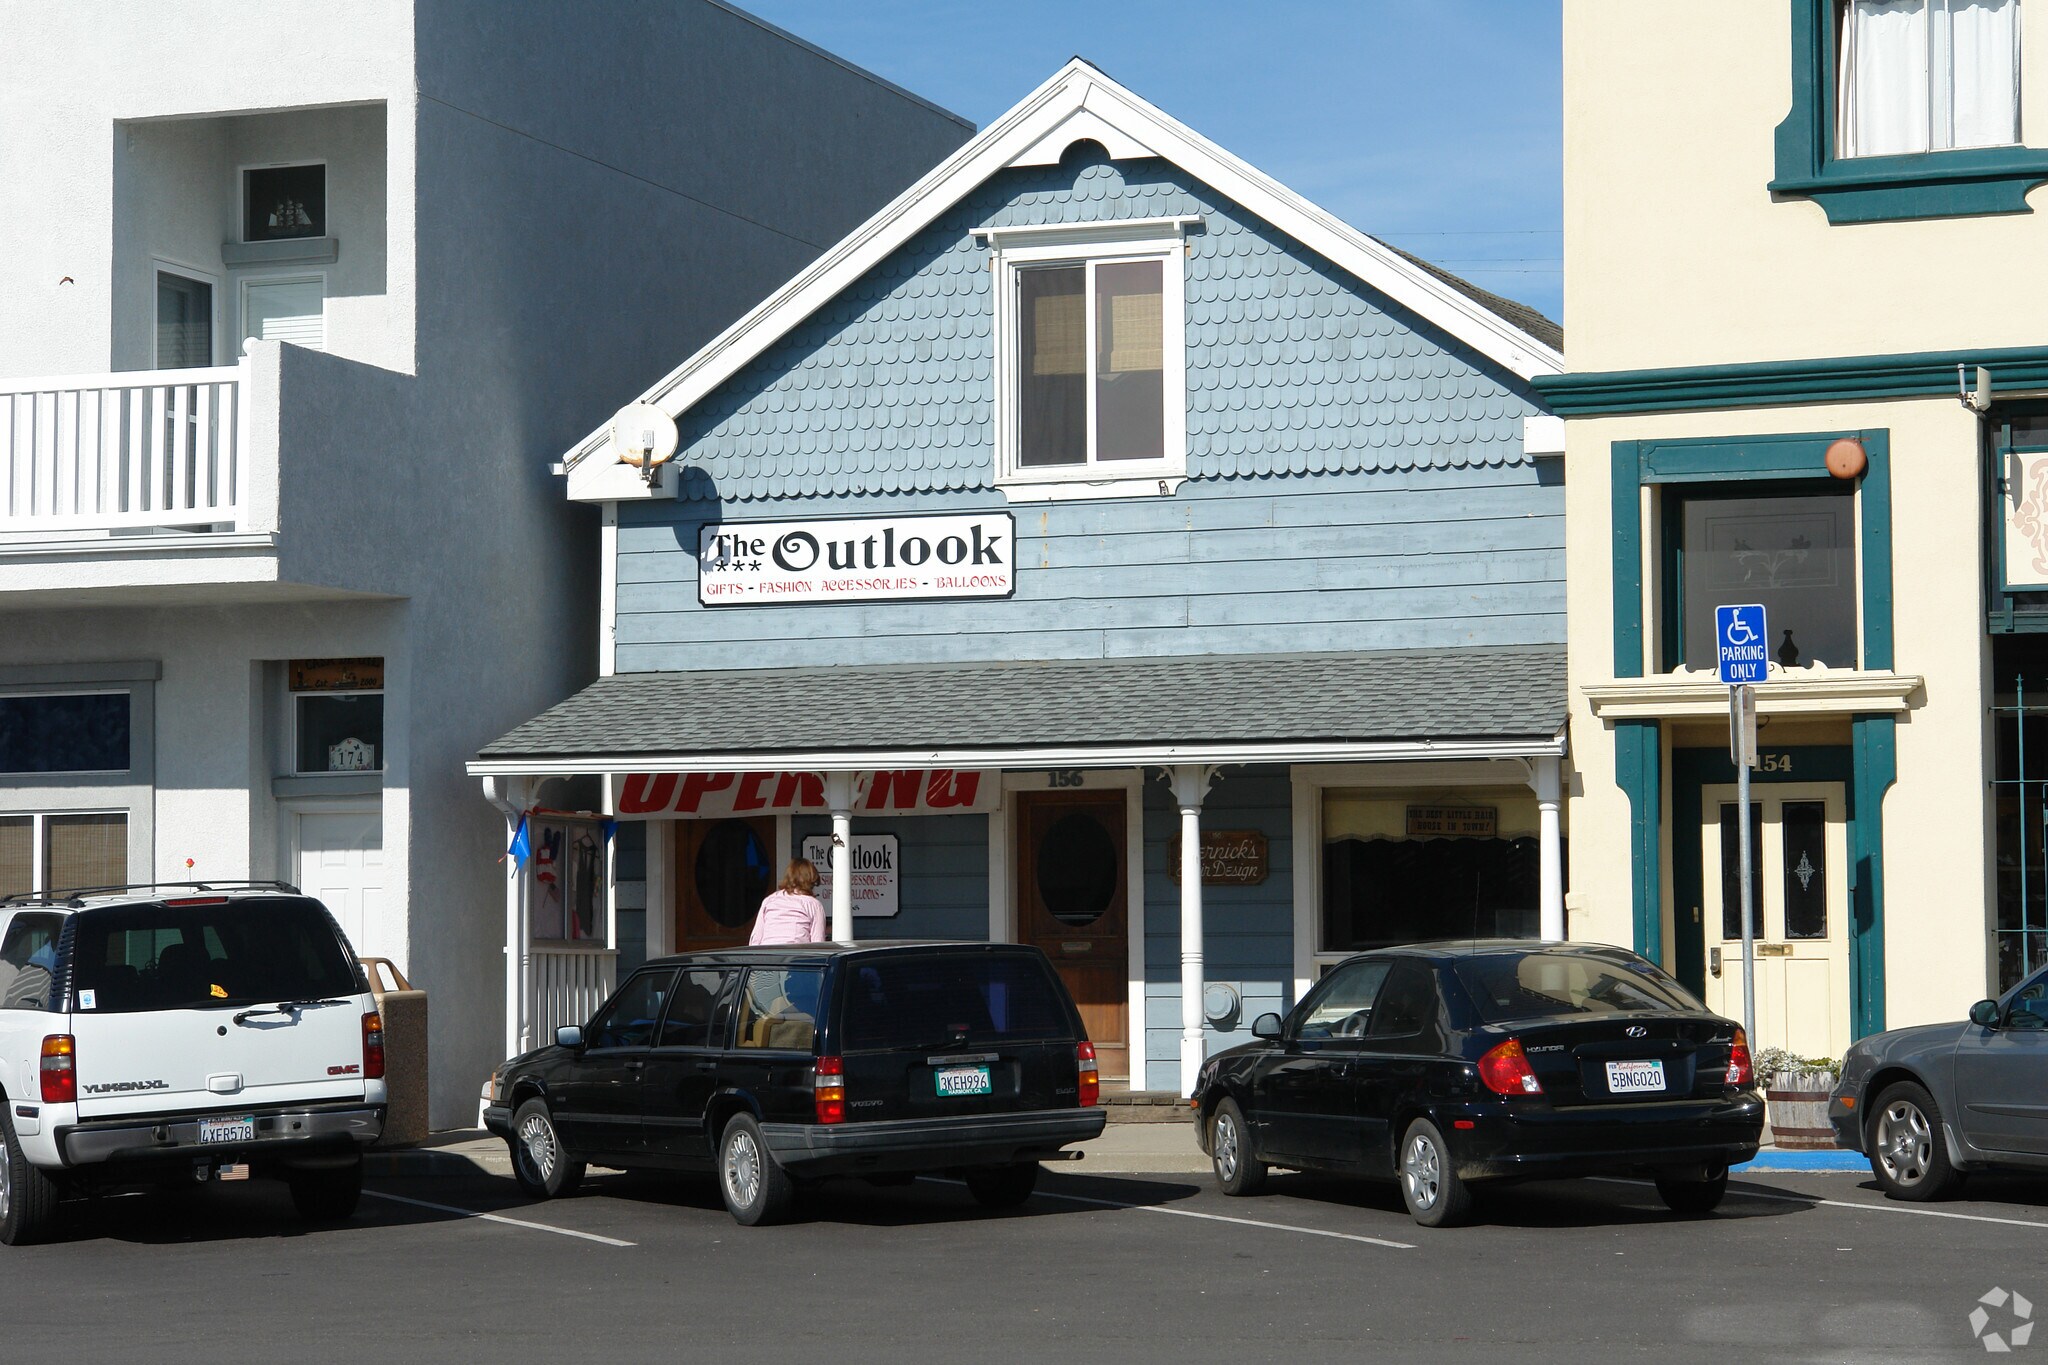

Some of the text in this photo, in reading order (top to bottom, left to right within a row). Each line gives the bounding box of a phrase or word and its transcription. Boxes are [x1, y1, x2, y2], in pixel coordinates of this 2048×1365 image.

[710, 524, 1003, 572] The Outlook
[707, 582, 744, 595] GIFTS
[759, 581, 812, 594] FASHION
[821, 577, 918, 592] ACCESSORIES
[934, 575, 1007, 589] BALLOONS
[1721, 645, 1764, 661] PARKING
[1730, 663, 1757, 679] ONLY
[339, 751, 363, 765] 174
[1752, 753, 1792, 772] 154
[1048, 770, 1084, 787] 156
[618, 768, 981, 813] OPENNG
[809, 844, 892, 870] The Otlook
[1180, 840, 1259, 859] ernick's
[1213, 860, 1257, 880] Design
[851, 874, 887, 886] ESSORIES
[851, 888, 879, 900] ALLOONS
[327, 1064, 360, 1075] GMC
[1618, 1062, 1651, 1072] California
[940, 1074, 987, 1091] 3KEH996
[1612, 1071, 1661, 1087] 5BNG020
